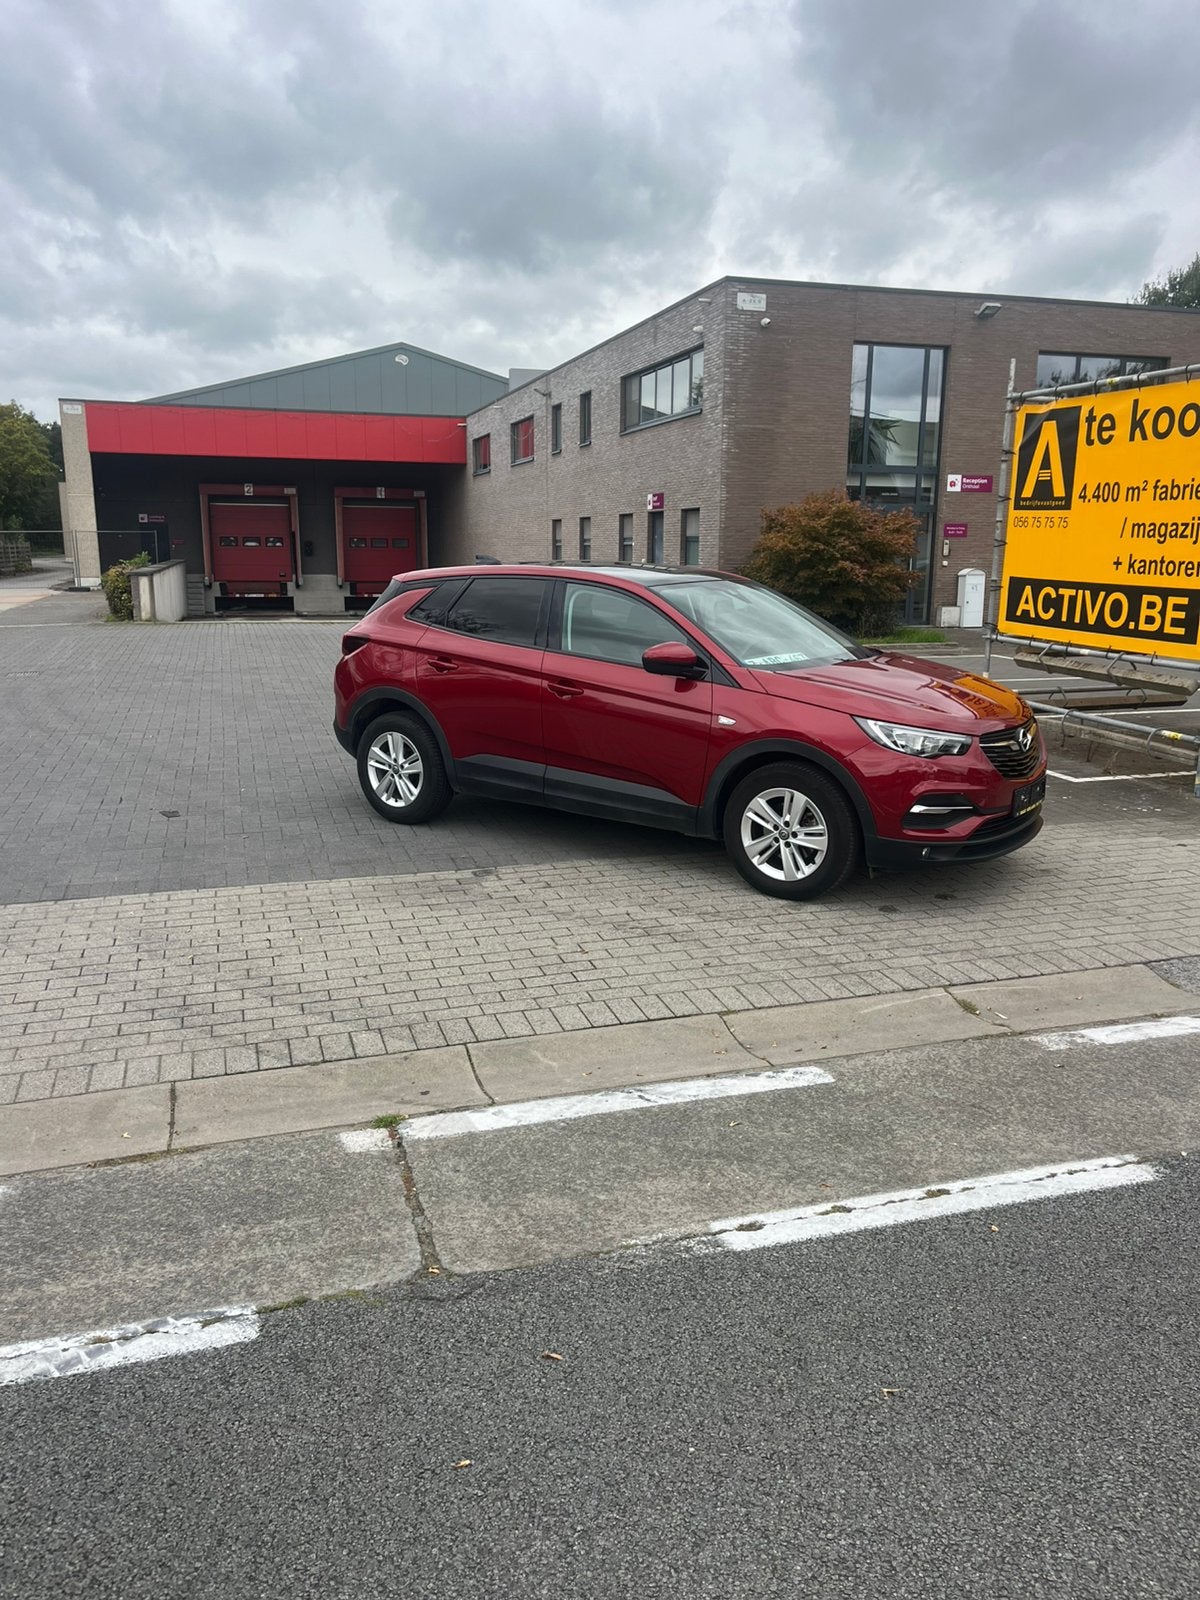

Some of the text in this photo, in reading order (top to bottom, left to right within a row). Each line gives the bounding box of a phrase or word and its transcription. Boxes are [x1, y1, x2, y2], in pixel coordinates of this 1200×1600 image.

[1085, 398, 1200, 447] te koo
[962, 477, 988, 485] Reception
[1078, 481, 1121, 503] 4.400
[1013, 516, 1069, 528] 056 75 75 75
[1015, 585, 1190, 635] ACTIVO.BE
